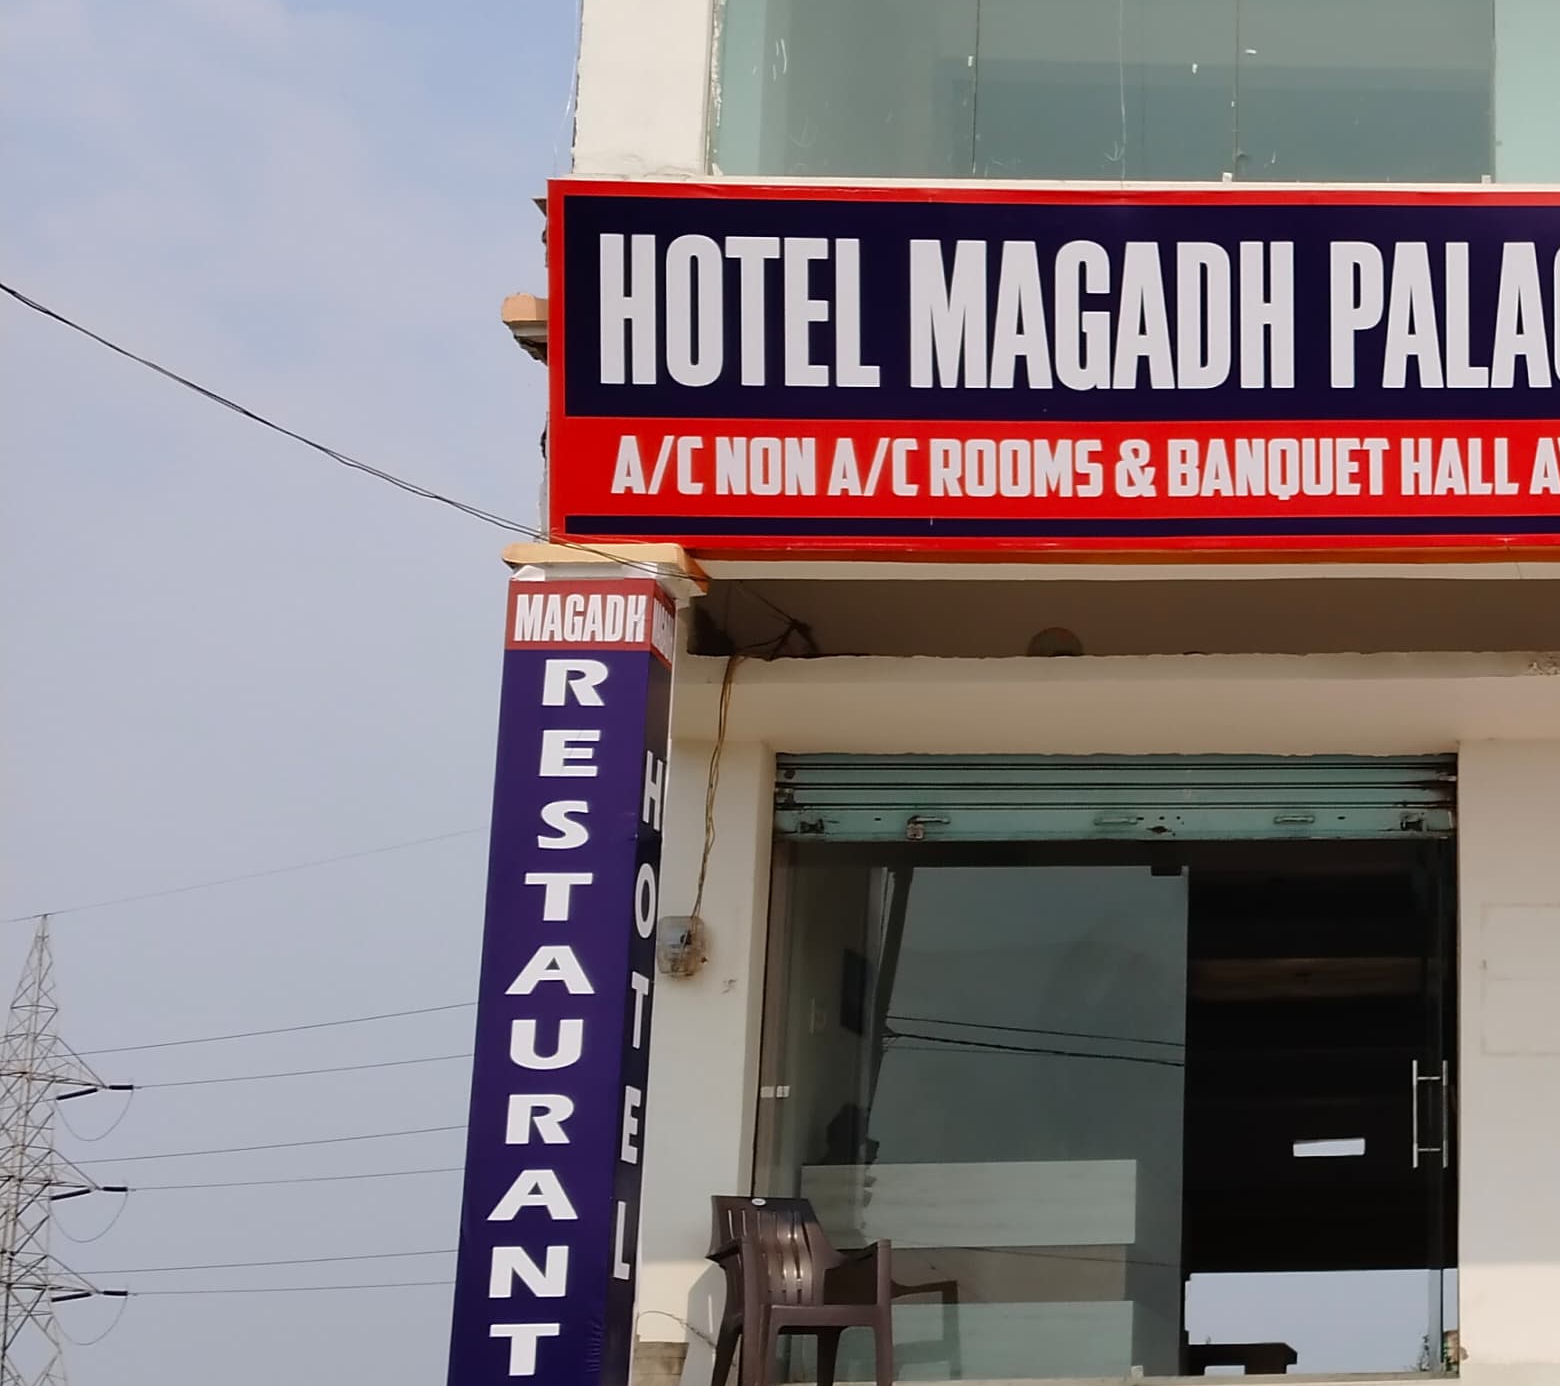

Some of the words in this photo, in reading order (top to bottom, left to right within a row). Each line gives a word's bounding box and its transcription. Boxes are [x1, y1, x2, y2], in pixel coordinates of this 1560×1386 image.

[599, 233, 881, 388] HOTEL
[910, 239, 1295, 391] MAGADH
[611, 435, 703, 495] A/C
[716, 436, 816, 496] NON
[828, 437, 918, 496] A/C
[930, 438, 1103, 497] ROOMS
[1115, 439, 1156, 498] &
[1168, 438, 1390, 501] BANQUET
[1401, 437, 1519, 496] HALL
[513, 593, 648, 643] MAGADH
[487, 659, 609, 1376] RESTAURANT
[612, 749, 664, 1281] HOTEL
